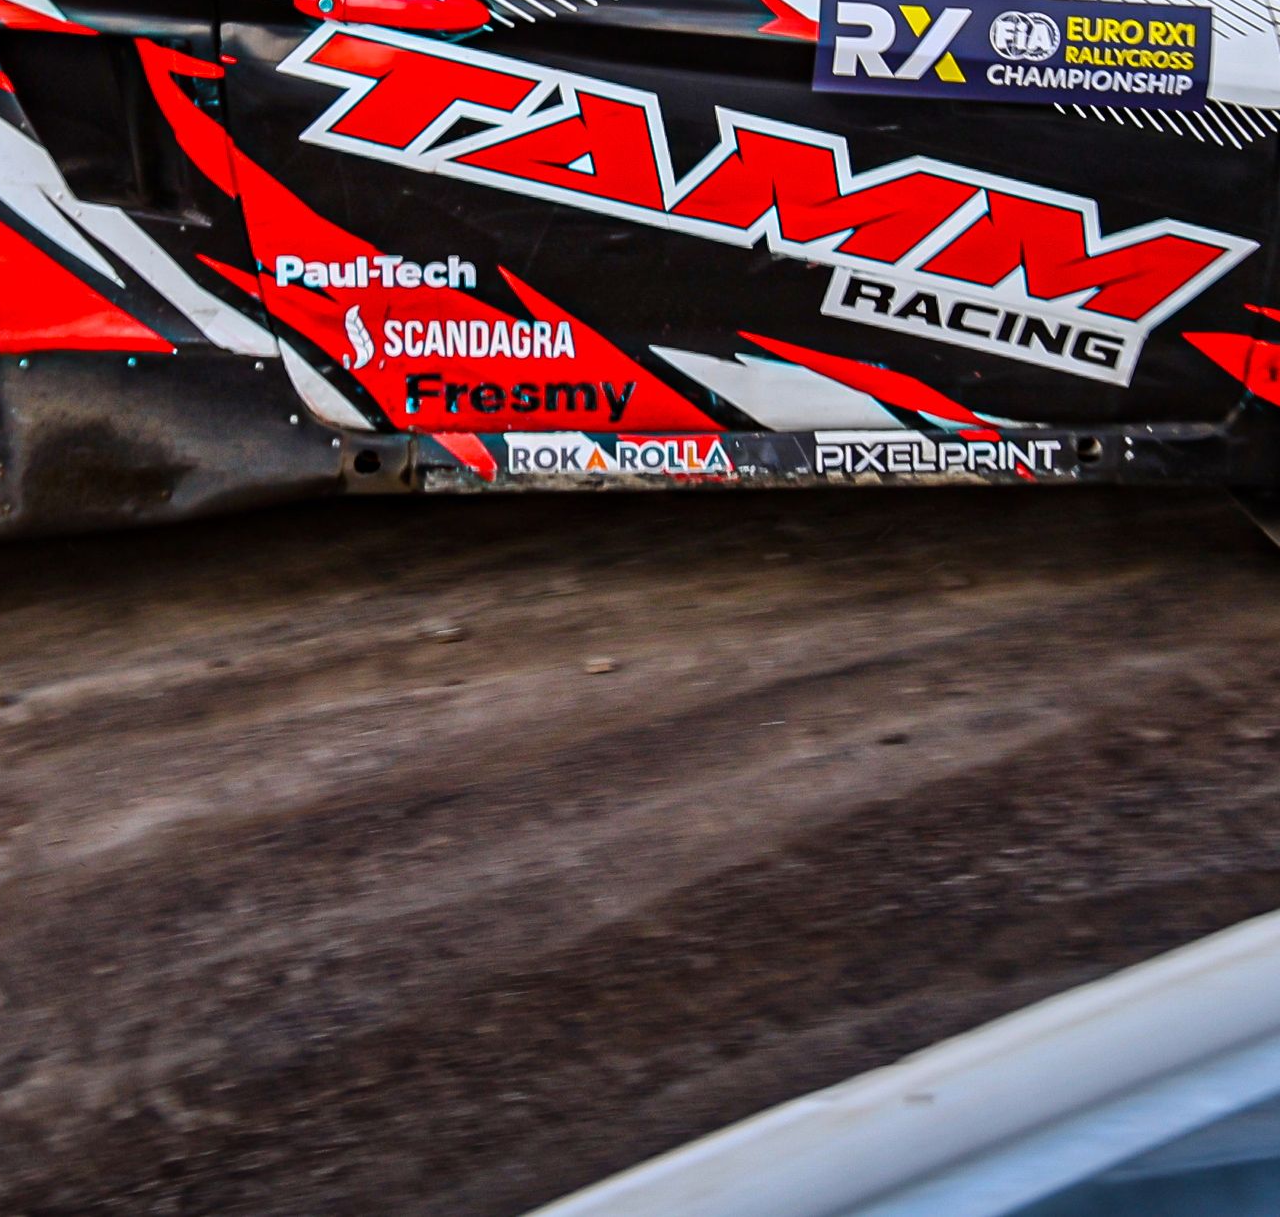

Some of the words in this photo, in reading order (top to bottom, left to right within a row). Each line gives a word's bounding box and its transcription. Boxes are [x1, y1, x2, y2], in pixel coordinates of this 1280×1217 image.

[834, 1, 973, 82] RX
[1066, 16, 1144, 45] EURO
[1148, 20, 1197, 48] RX1
[1065, 45, 1195, 71] RALLYCROSS
[986, 63, 1194, 95] CHAMPIONSHIP
[300, 30, 1232, 324] TAMM
[276, 255, 477, 288] Paul-Tech
[384, 320, 576, 359] SCANDAGRA
[841, 277, 1125, 370] RACING
[405, 373, 637, 423] Fresmy
[619, 444, 732, 472] ROLLA
[816, 440, 1061, 475] PIXELPRINT
